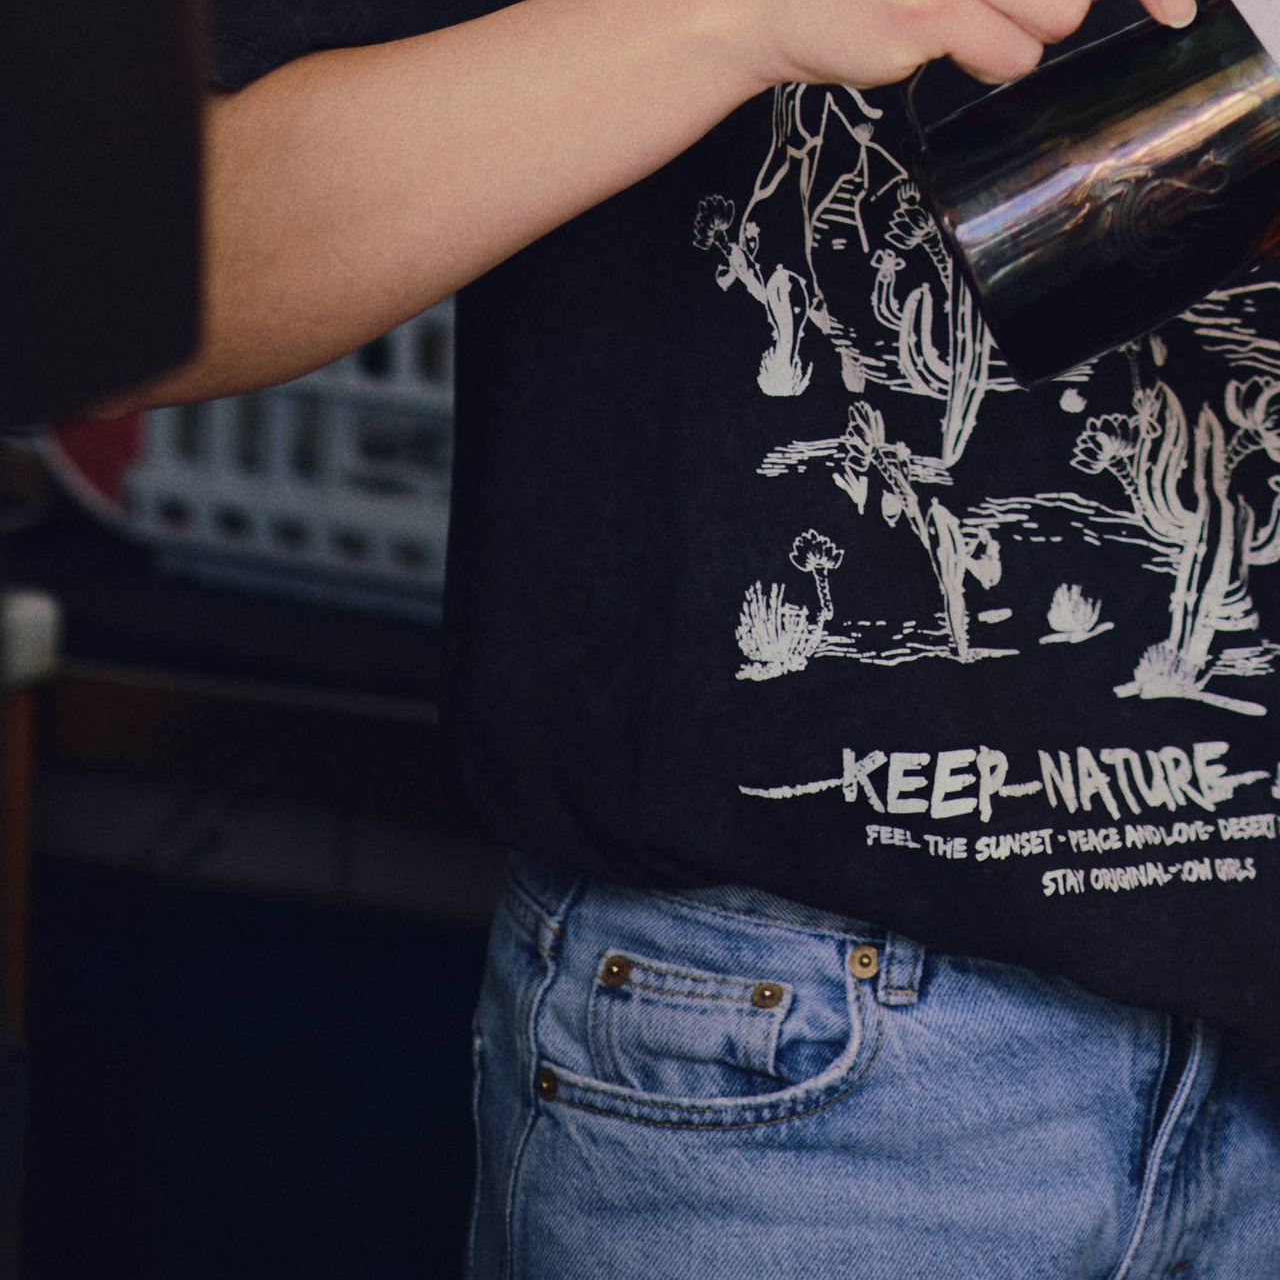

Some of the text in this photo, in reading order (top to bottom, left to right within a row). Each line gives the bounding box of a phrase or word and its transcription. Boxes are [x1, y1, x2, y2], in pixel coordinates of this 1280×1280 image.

[842, 745, 1009, 823] KEEP
[1037, 741, 1234, 821] NATURE
[865, 824, 921, 849] FEEL
[923, 833, 969, 860] THE
[975, 828, 1054, 863] SUNSET
[1067, 827, 1123, 854] PEACE
[1217, 813, 1277, 841] DESERT
[1041, 868, 1085, 897] STAY
